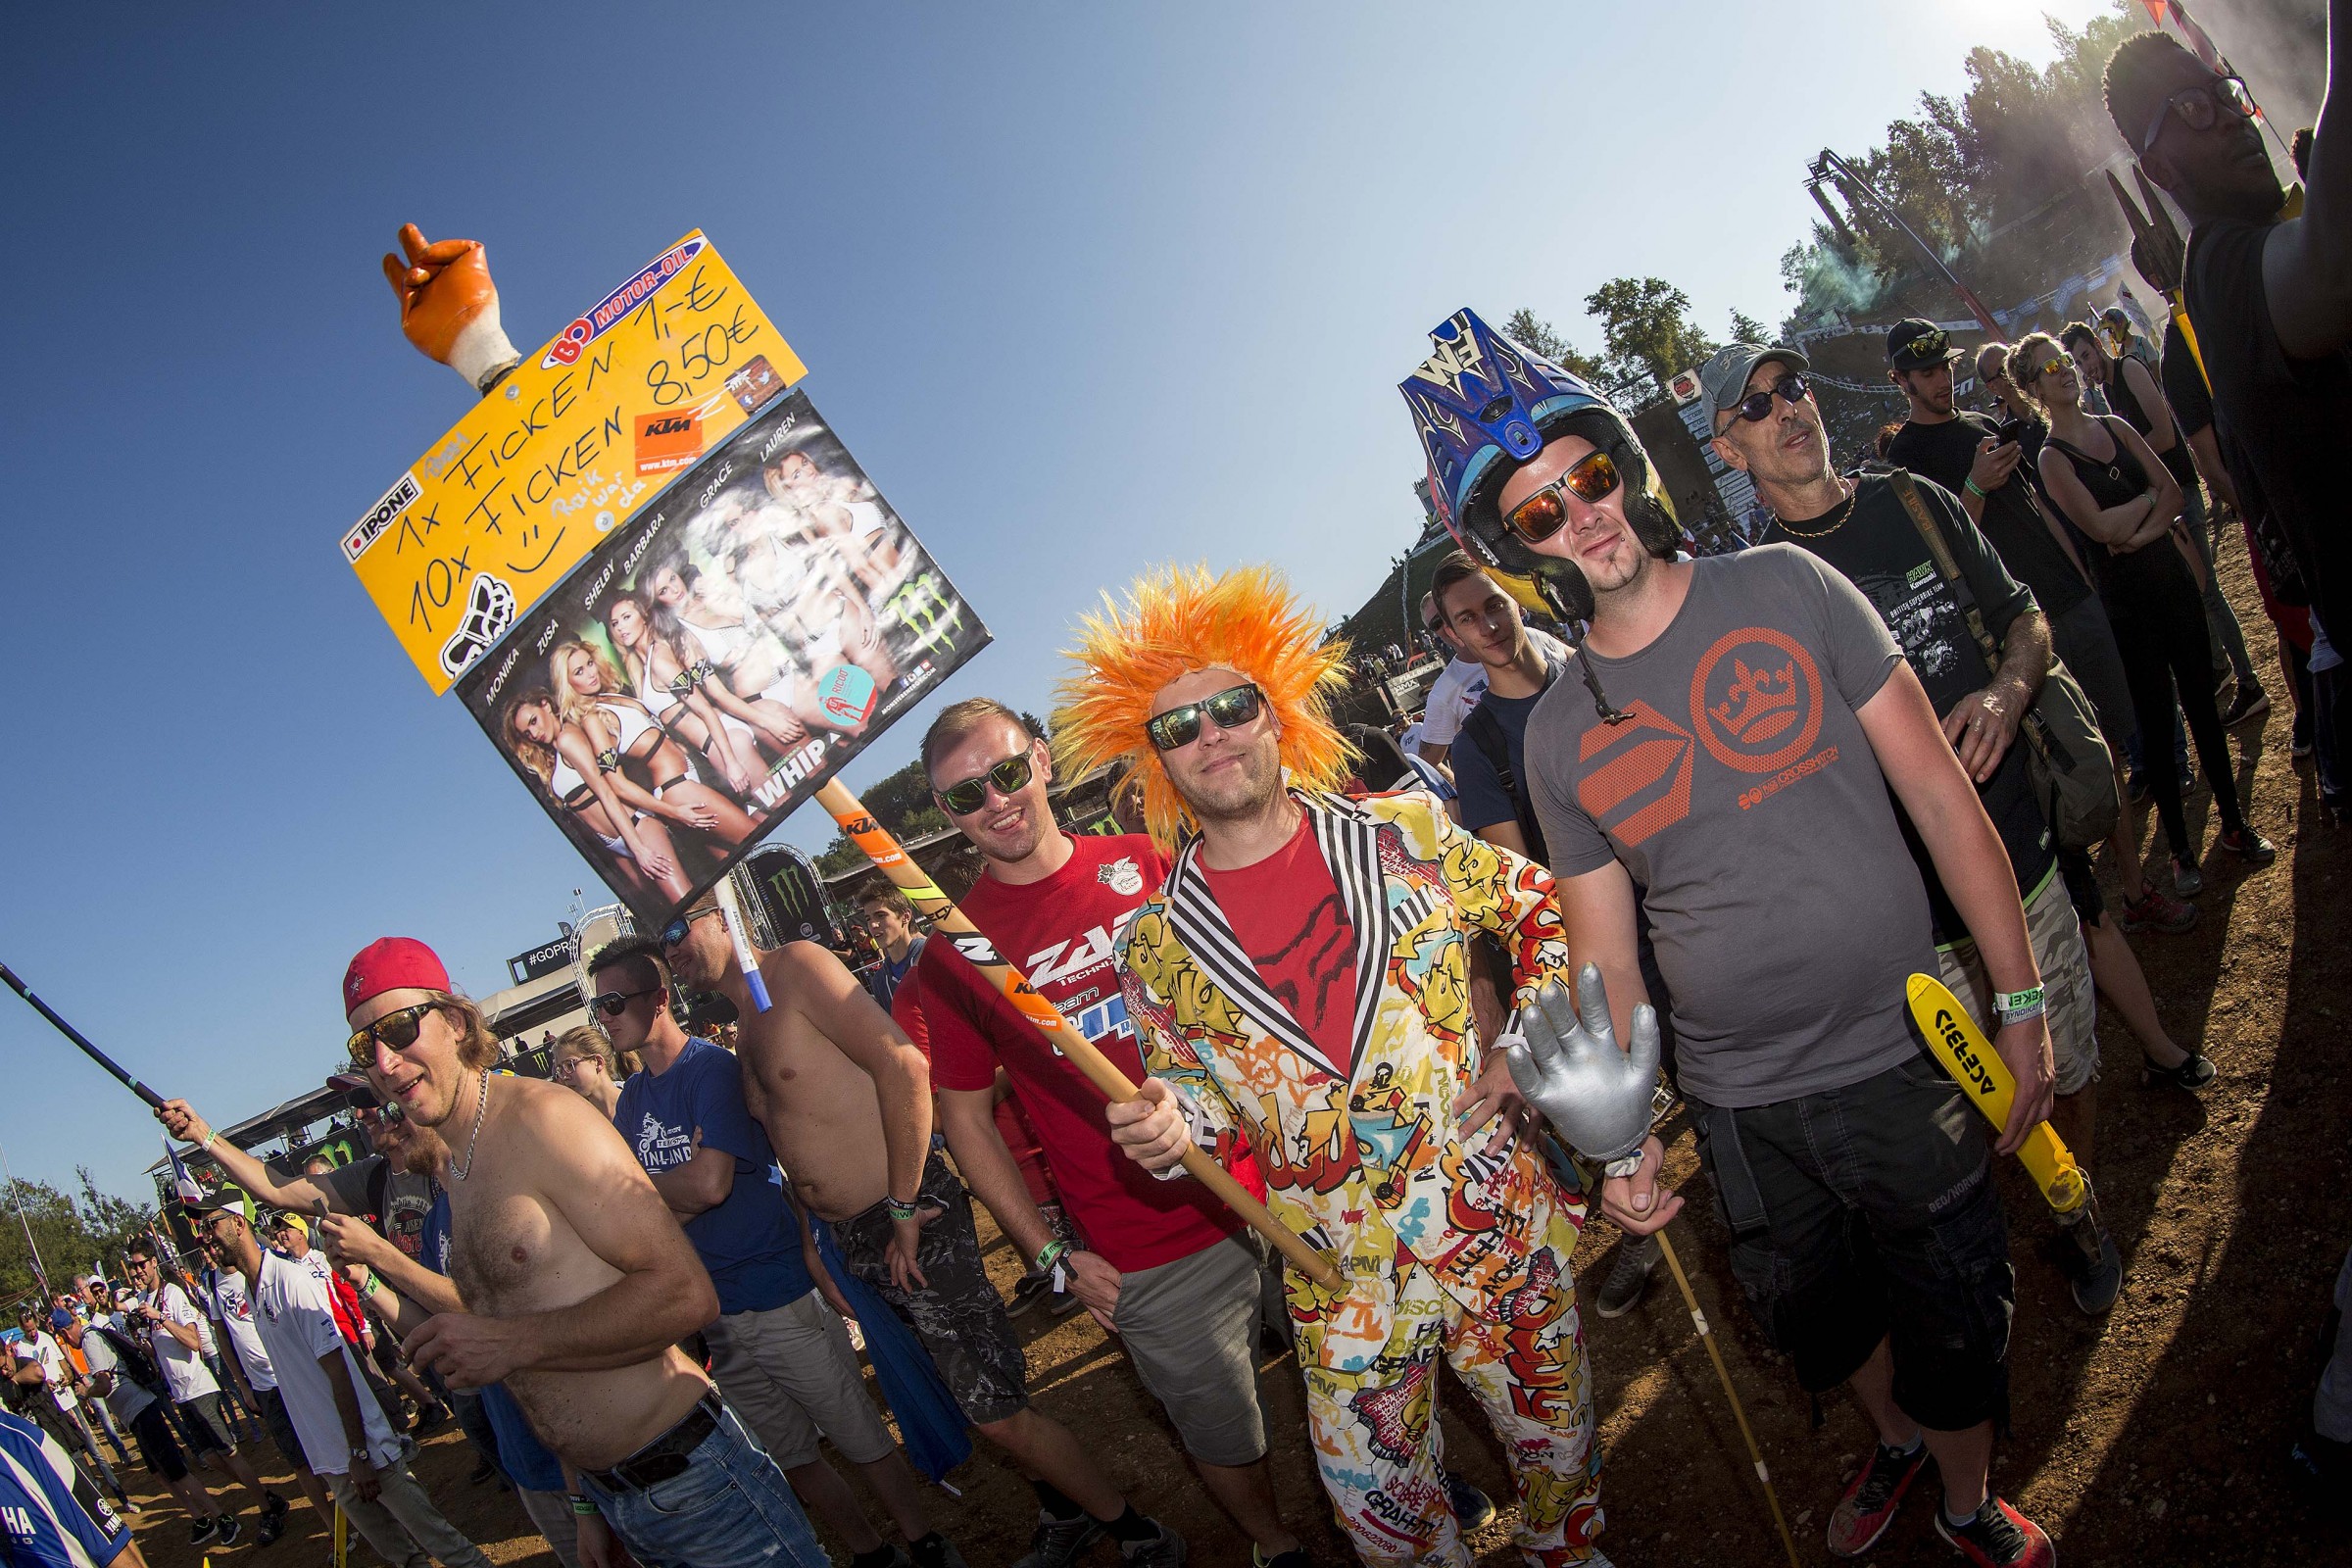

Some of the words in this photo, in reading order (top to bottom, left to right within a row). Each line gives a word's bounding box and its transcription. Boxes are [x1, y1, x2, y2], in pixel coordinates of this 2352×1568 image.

[551, 317, 595, 366] BO
[595, 247, 693, 328] MOTOR-OIL
[396, 502, 440, 555] 1x
[443, 340, 614, 490] FICKEN
[645, 416, 692, 437] KTM
[760, 412, 796, 463] LAUREN
[700, 461, 733, 509] GRACE
[361, 482, 415, 541] IPONE
[409, 543, 471, 633] 10x
[464, 405, 622, 536] FICKEN
[623, 513, 665, 576] BARBARA
[584, 559, 615, 612] SHELBY
[1905, 560, 1935, 584] HAWK
[1910, 571, 1937, 591] Kawasaki
[1889, 602, 1910, 618] BRITISH
[1909, 589, 1935, 608] SUPERBIKE
[1933, 582, 1945, 594] TEAM
[536, 618, 560, 656] ZUSA
[485, 648, 520, 707] MONIKA
[881, 666, 937, 715] MONSTERENERGY.COM
[754, 738, 827, 808] WHIP
[1778, 744, 1838, 783] CROSSHATCH
